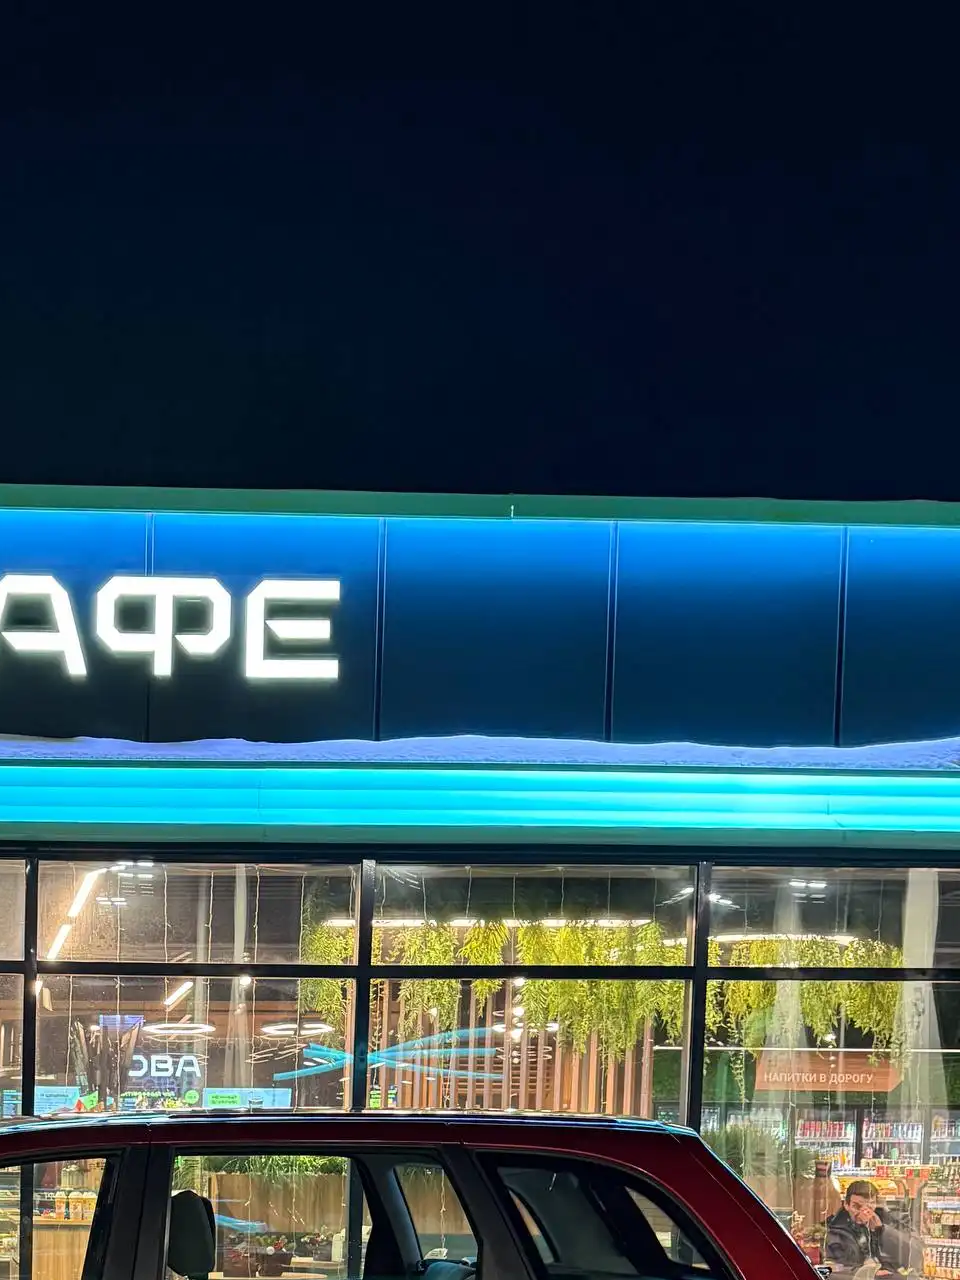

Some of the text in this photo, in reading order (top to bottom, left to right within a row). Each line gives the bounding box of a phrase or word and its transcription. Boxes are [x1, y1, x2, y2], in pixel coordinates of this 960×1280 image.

[763, 1072, 874, 1085] НАПИТКИ В ДОРОГУ
